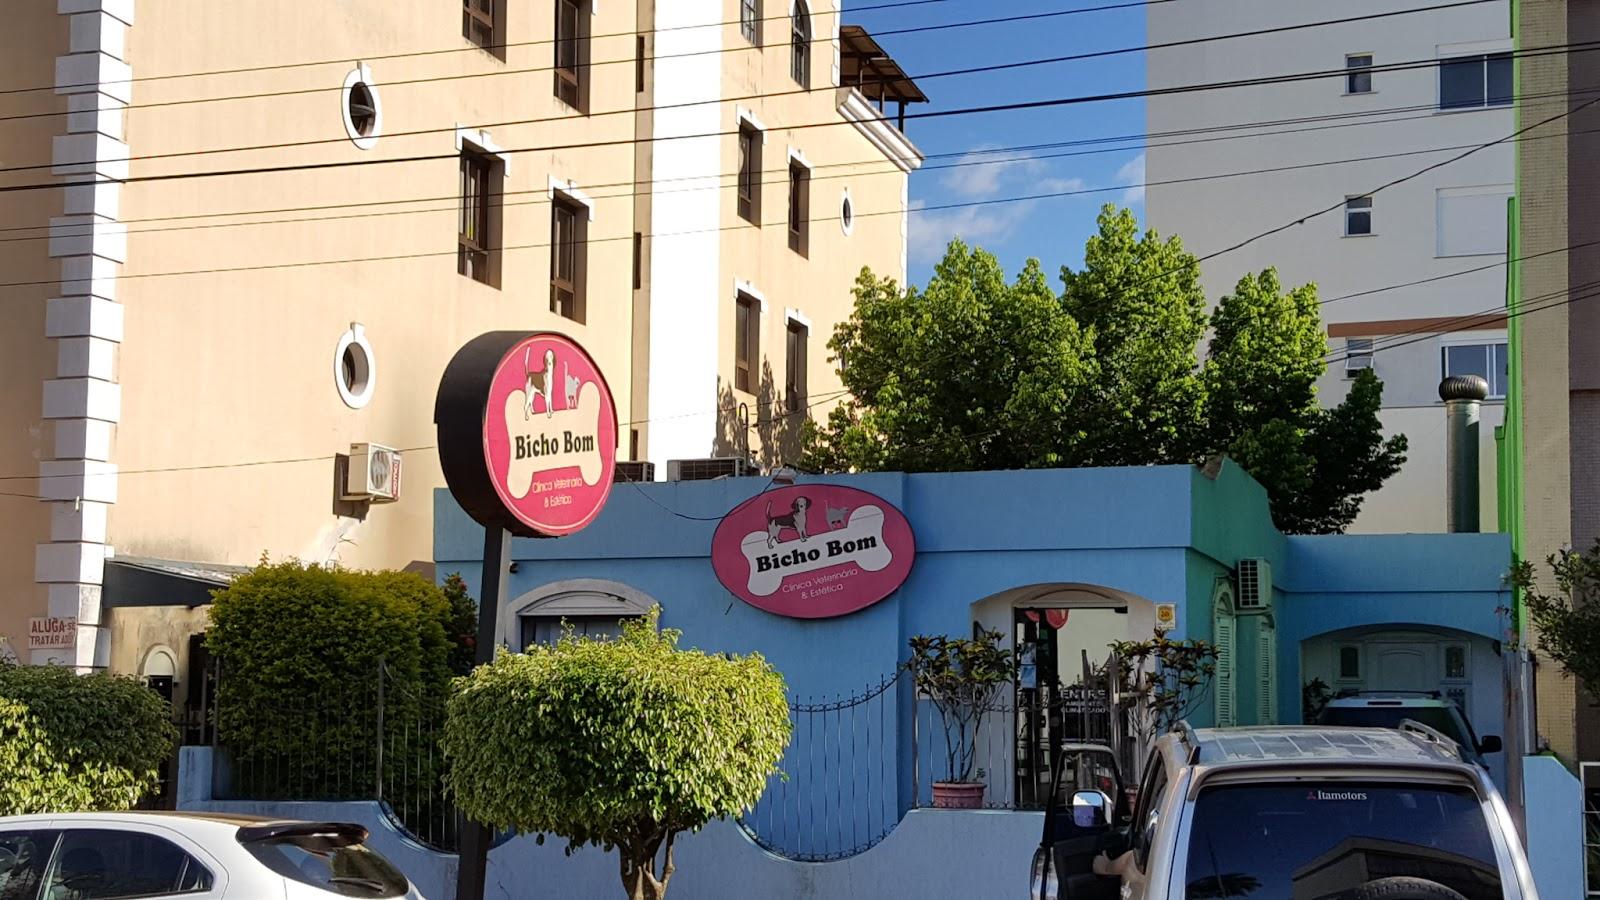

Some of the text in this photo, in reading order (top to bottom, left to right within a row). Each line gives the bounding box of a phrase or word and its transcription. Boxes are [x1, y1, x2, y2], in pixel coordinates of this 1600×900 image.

[515, 430, 594, 460] Bicho Bom
[756, 534, 878, 573] Bicho Bom
[801, 591, 809, 600] &
[31, 635, 60, 645] TRATAR
[1060, 689, 1106, 699] ENTRE
[1317, 789, 1367, 801] Itamotors
